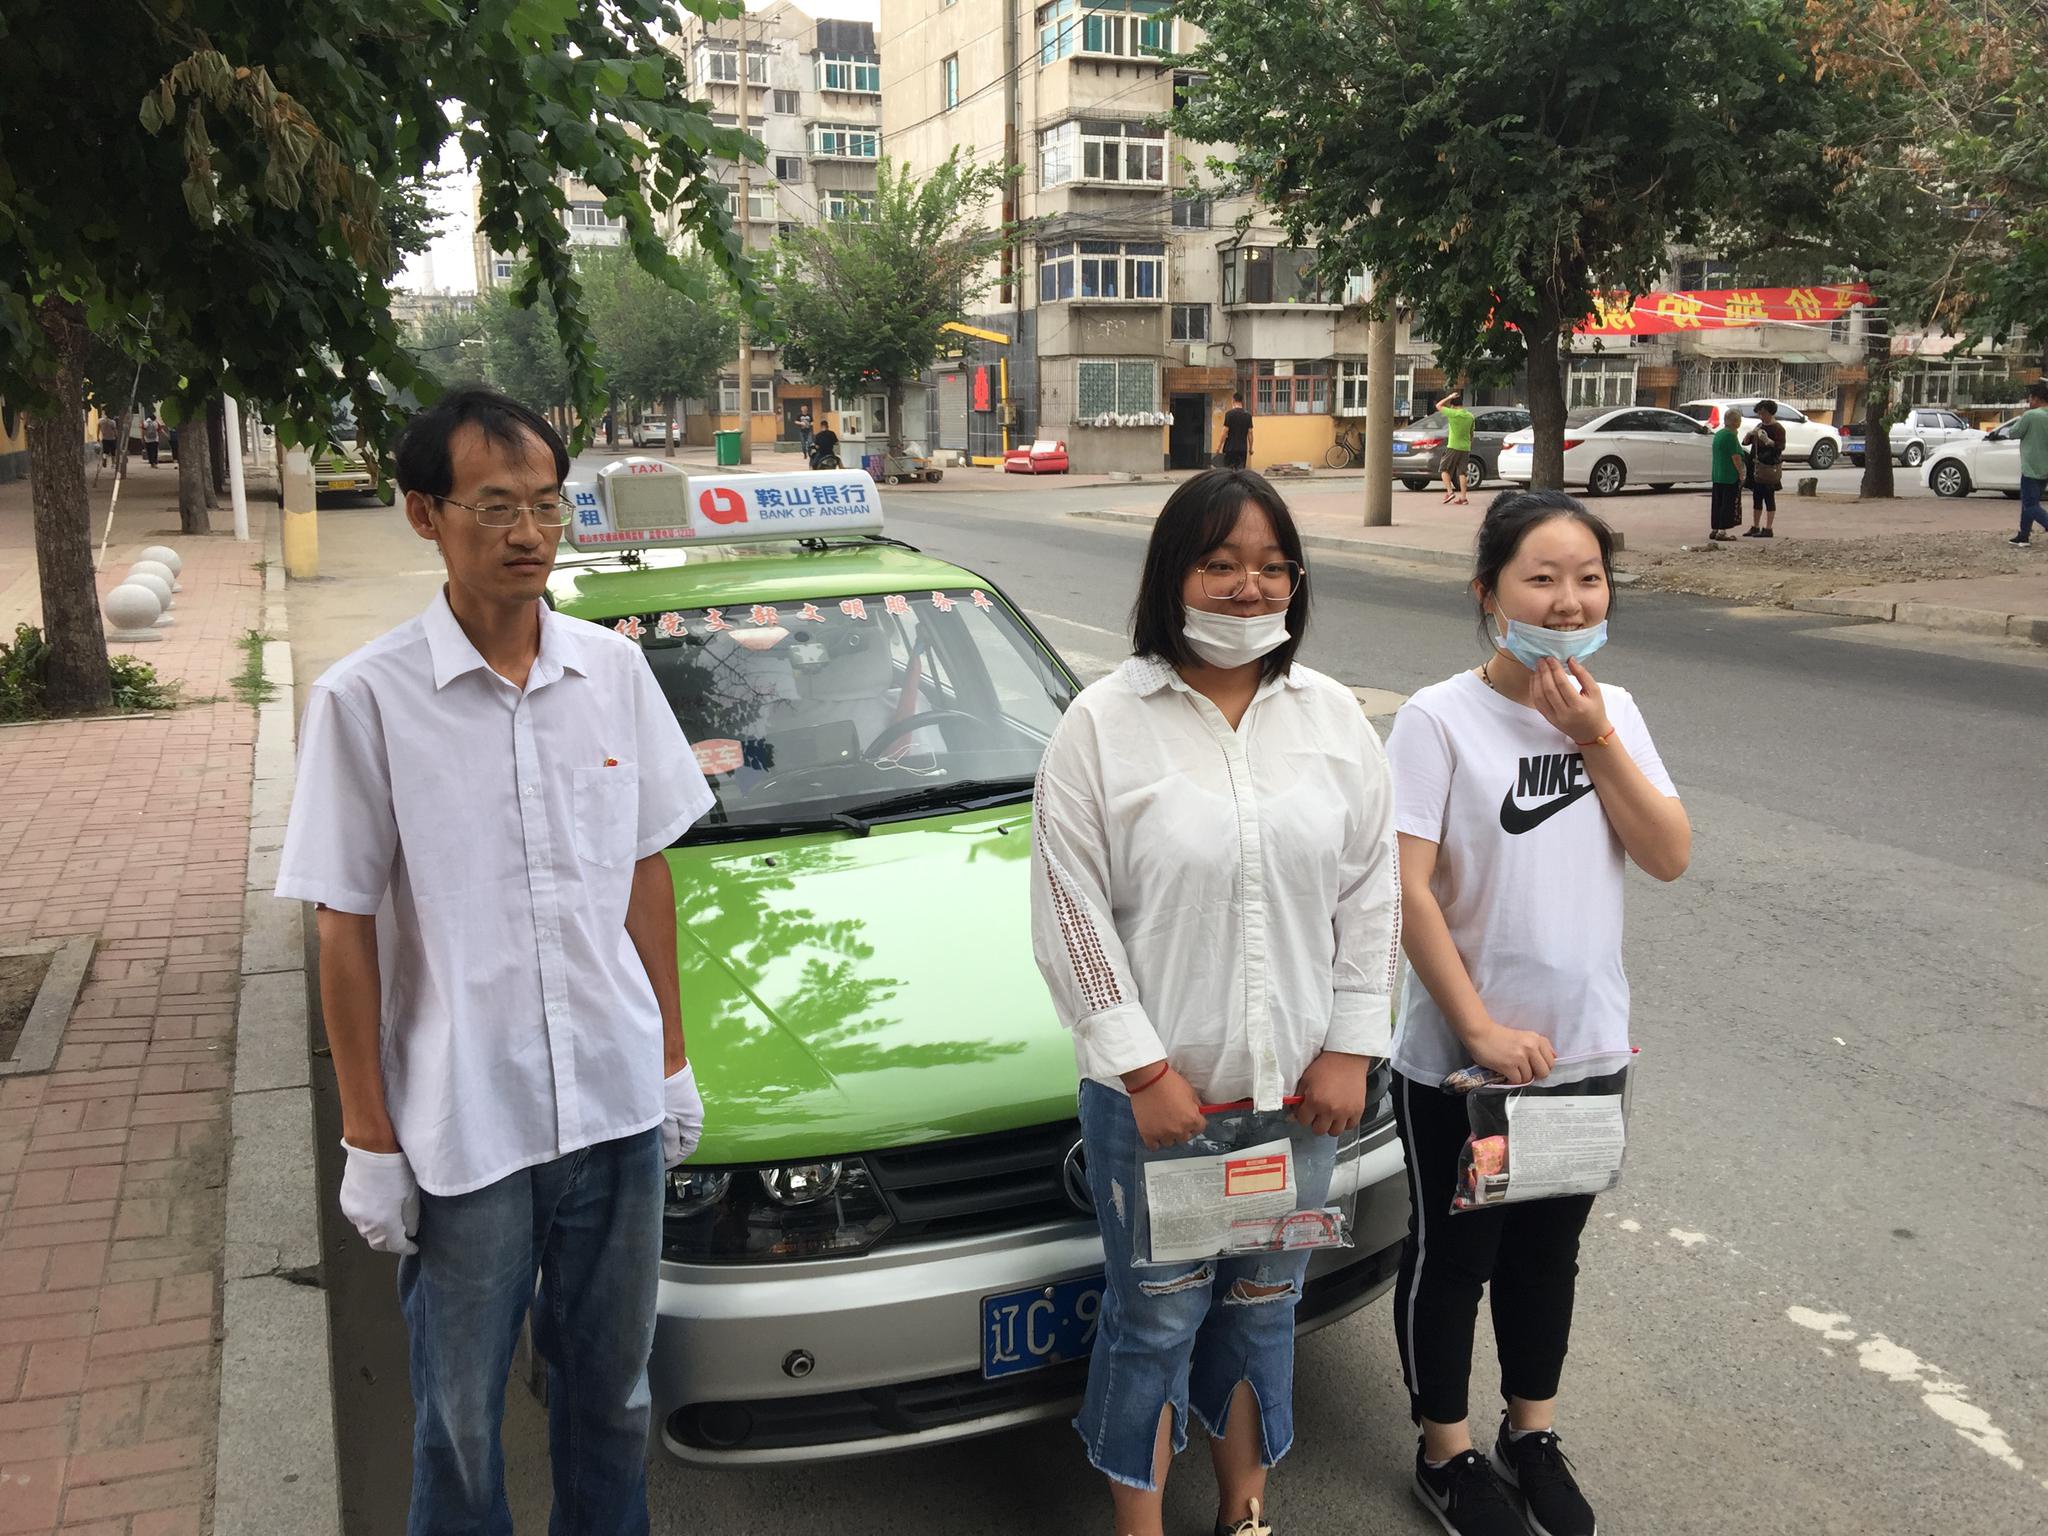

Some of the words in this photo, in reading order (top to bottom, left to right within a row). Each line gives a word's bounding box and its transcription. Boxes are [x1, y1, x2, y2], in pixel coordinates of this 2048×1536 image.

[629, 464, 664, 474] TAXI
[755, 484, 866, 508] 鞍山银行
[576, 492, 602, 527] 出租
[760, 508, 795, 520] BANK
[799, 507, 816, 518] OF
[819, 504, 870, 517] ANSHAN
[1516, 753, 1584, 797] NIKE
